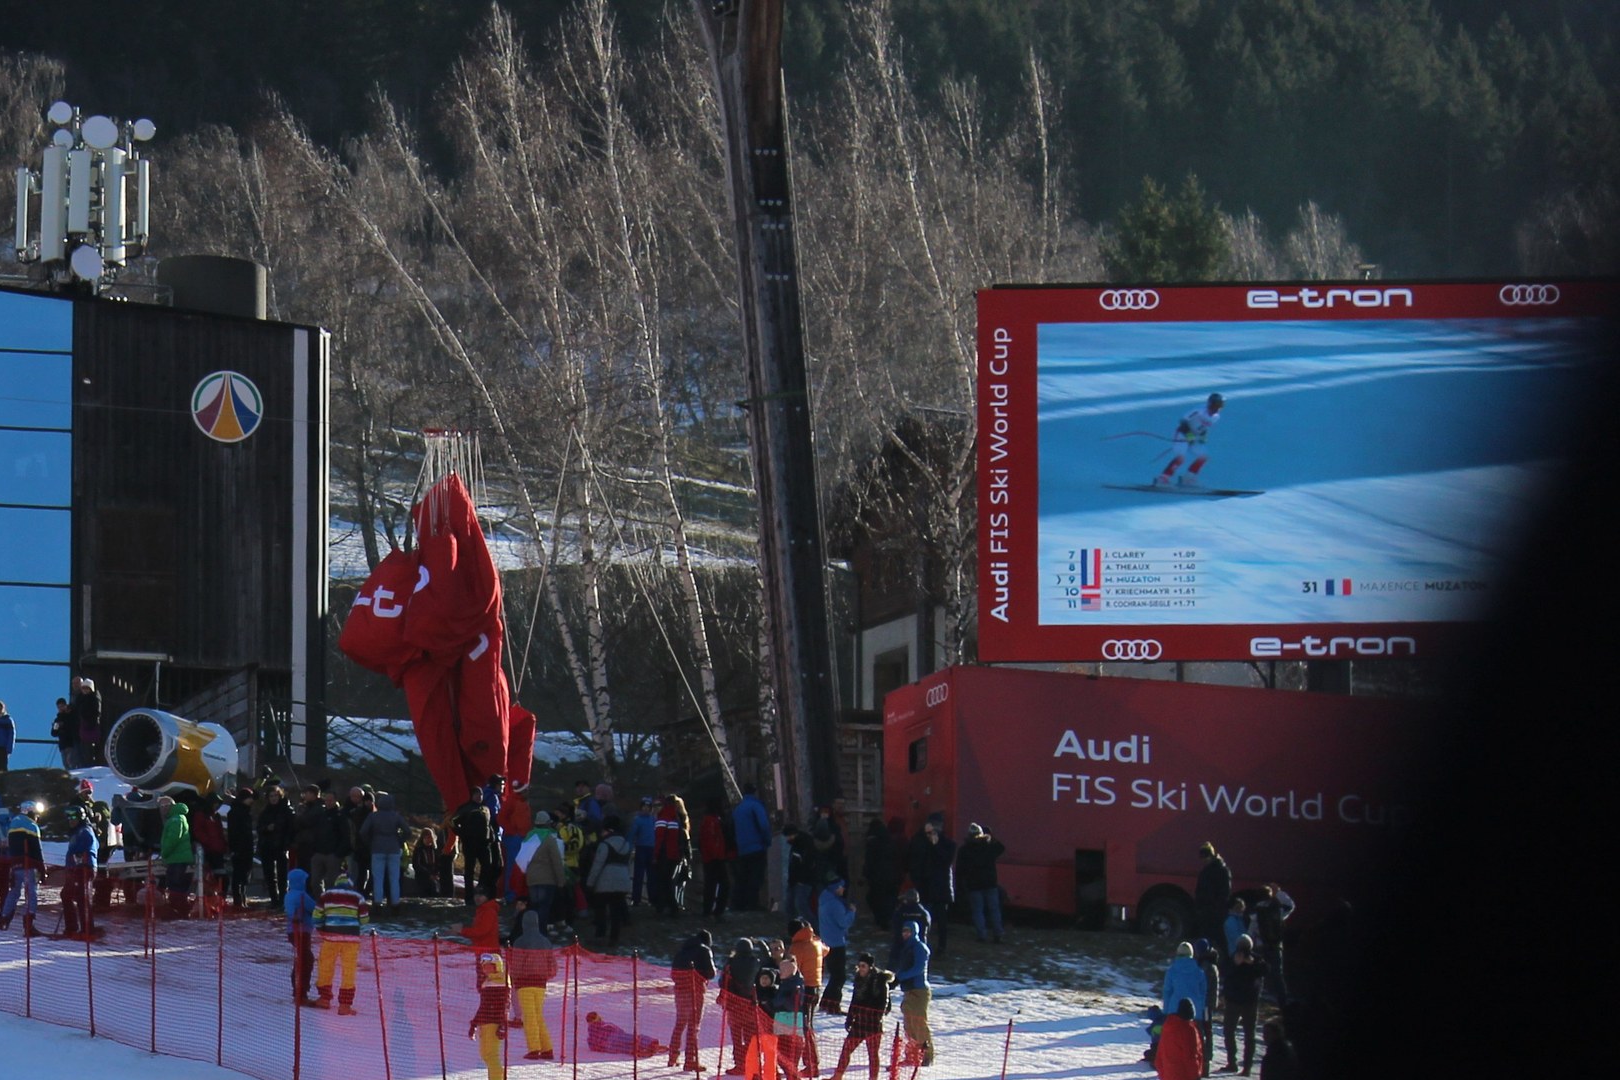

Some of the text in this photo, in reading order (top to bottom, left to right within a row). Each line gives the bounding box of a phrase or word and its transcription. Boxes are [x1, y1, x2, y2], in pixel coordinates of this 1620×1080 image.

[1247, 287, 1413, 308] e-tron
[990, 327, 1012, 623] Audi FIS Ski World Cup
[1065, 587, 1079, 596] 10
[1302, 581, 1318, 593] 31
[1360, 581, 1420, 592] MAXENCE
[1068, 600, 1077, 608] 11
[1250, 635, 1416, 656] e-tron
[1053, 729, 1150, 764] Audi
[1051, 773, 1117, 806] FIS
[1130, 778, 1187, 811] Ski
[1198, 784, 1323, 821] World
